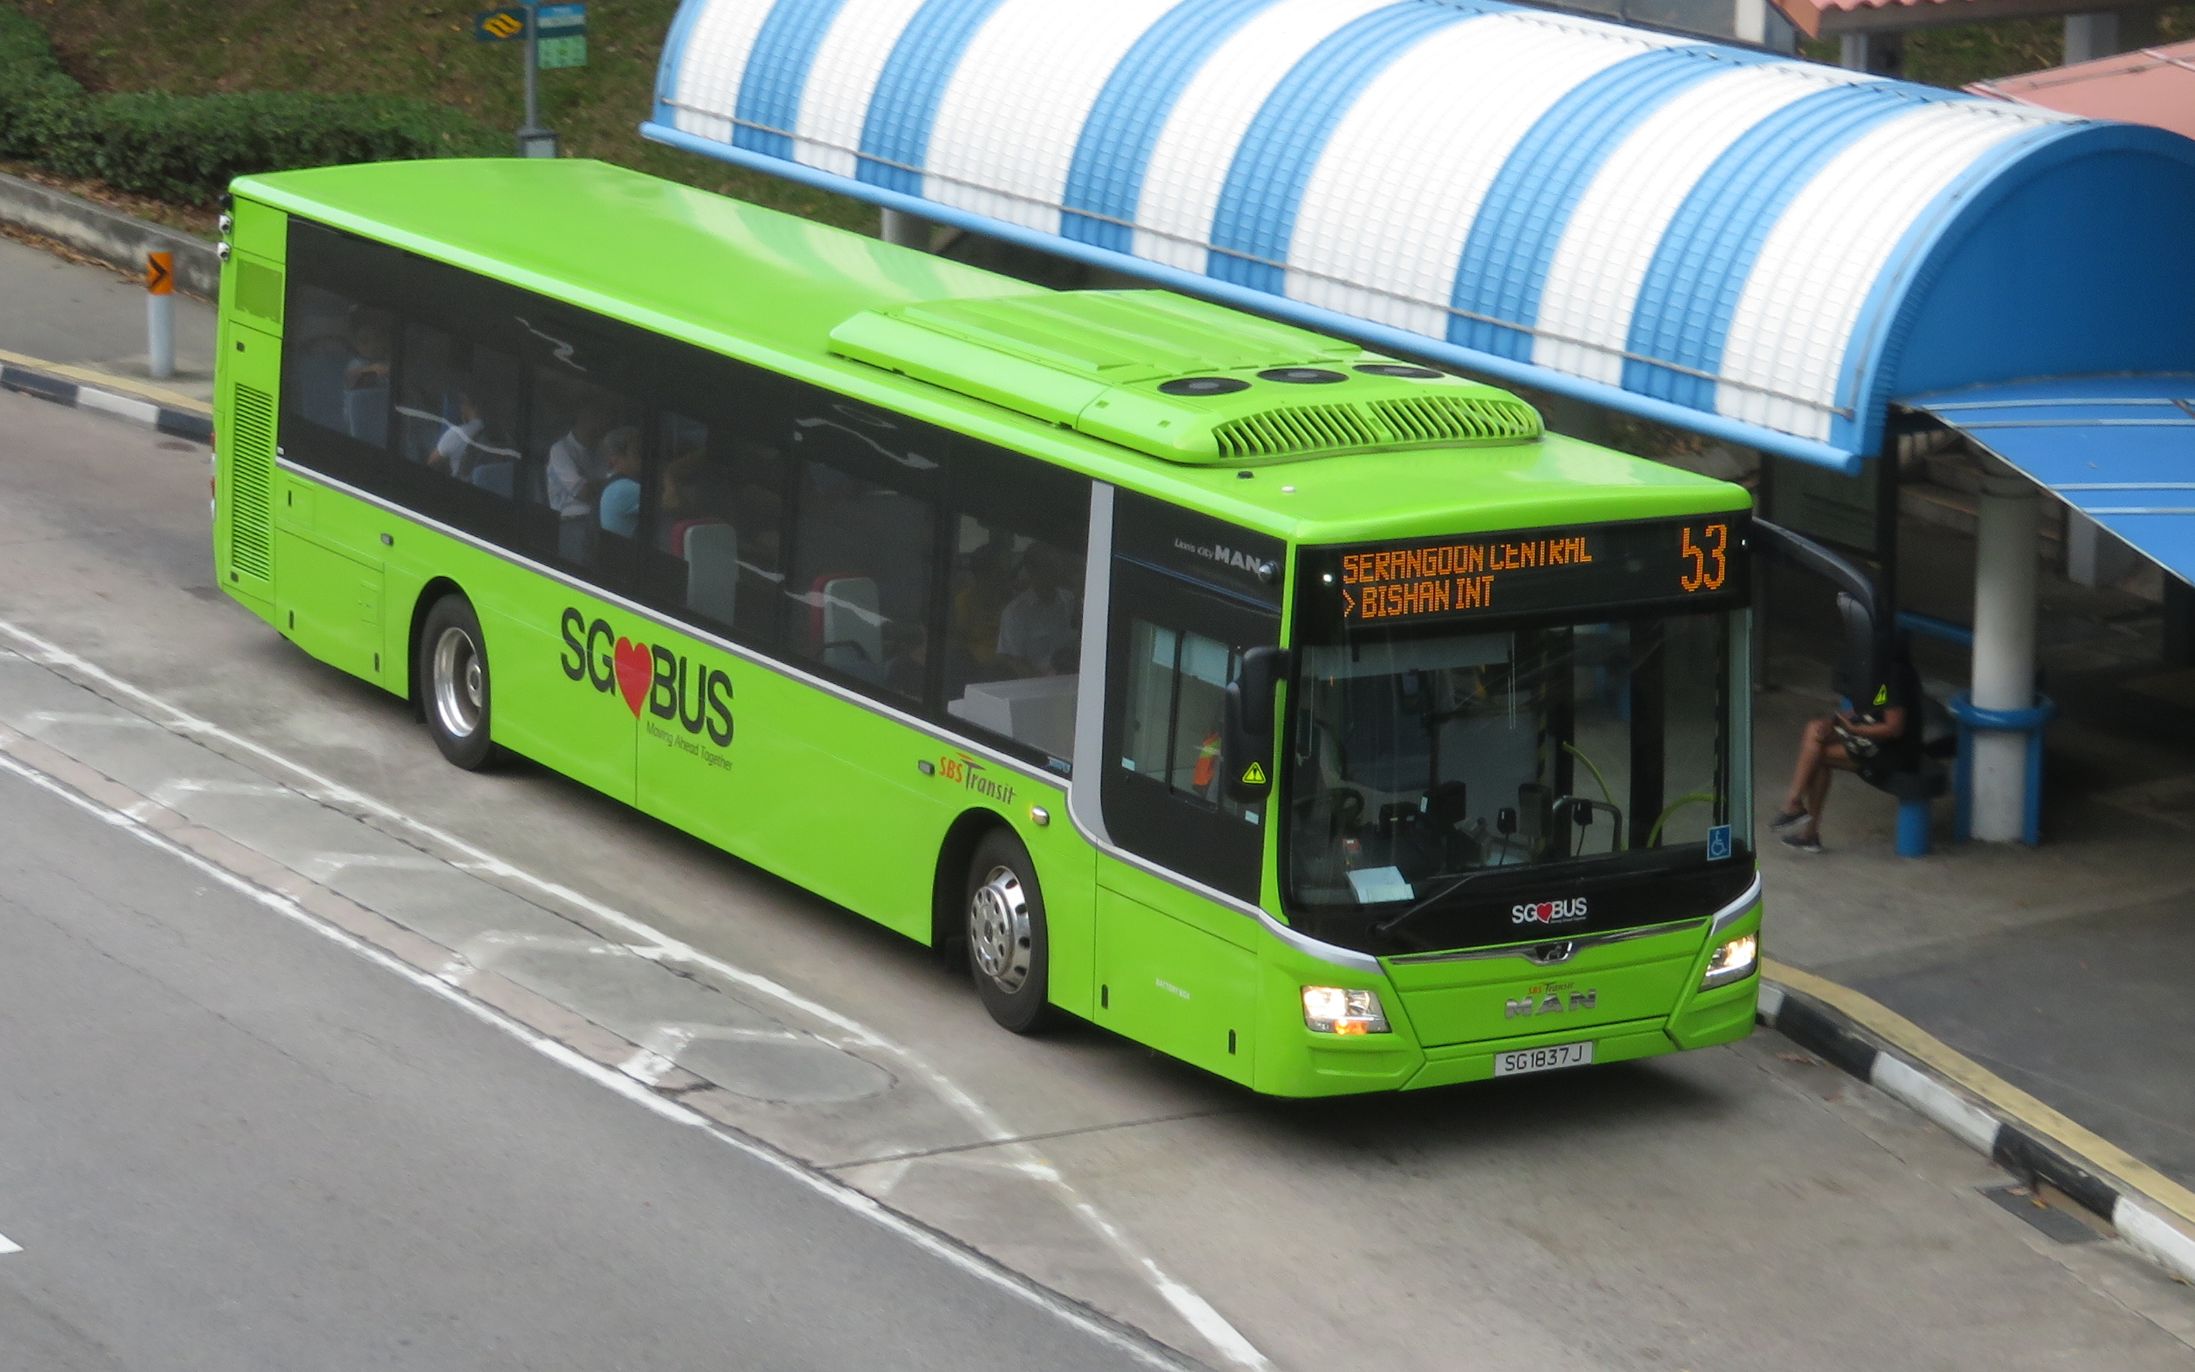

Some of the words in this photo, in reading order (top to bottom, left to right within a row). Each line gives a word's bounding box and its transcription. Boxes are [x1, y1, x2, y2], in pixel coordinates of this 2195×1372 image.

[1214, 545, 1261, 574] MAN
[1343, 545, 1484, 585] SERANGOON
[1680, 523, 1728, 592] 53
[1361, 579, 1450, 619] BISHAN
[1454, 575, 1495, 610] INT
[646, 720, 673, 747] Moving
[674, 734, 699, 756] Ahead
[700, 745, 733, 771] Together
[939, 756, 962, 783] SBS
[956, 752, 1017, 804] Transit
[1505, 989, 1596, 1019] MAN
[1504, 1045, 1583, 1072] SG1837J
